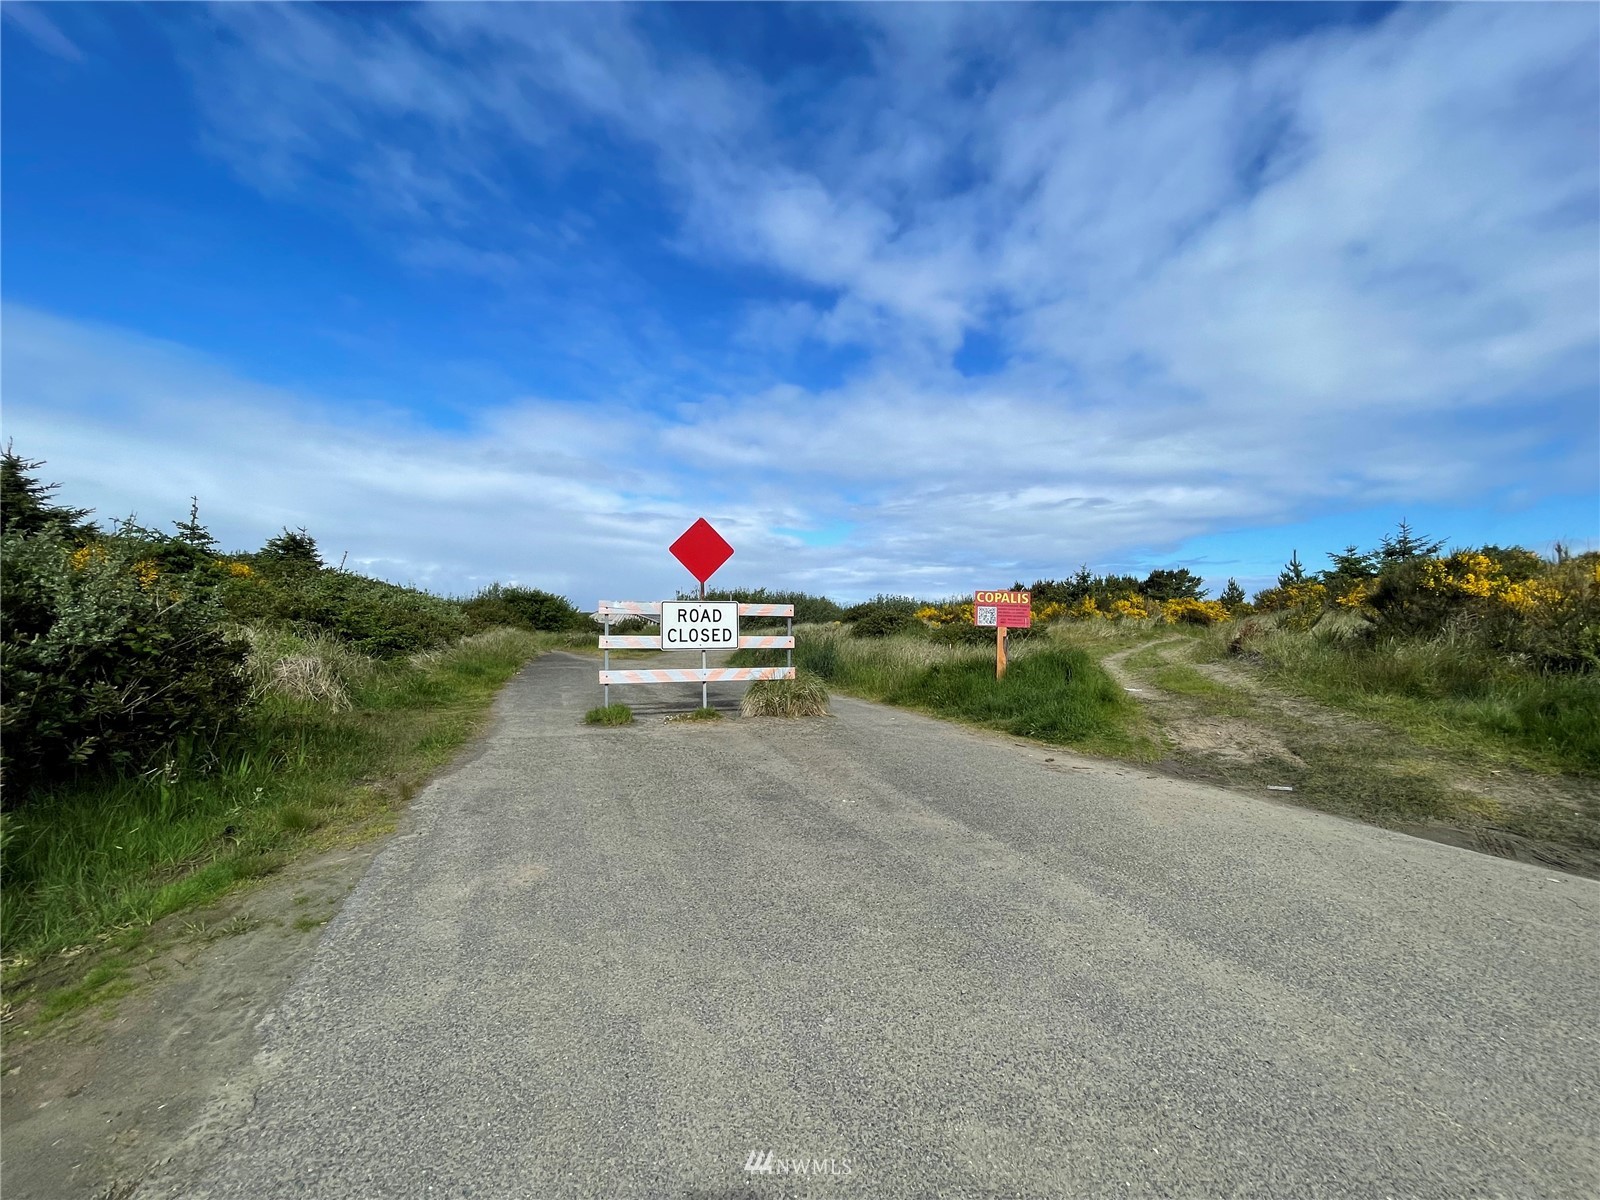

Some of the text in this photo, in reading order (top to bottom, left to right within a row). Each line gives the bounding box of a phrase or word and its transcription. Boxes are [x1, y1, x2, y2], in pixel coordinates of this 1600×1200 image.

[976, 592, 1029, 604] COPALIS
[677, 608, 722, 623] ROAD
[667, 628, 732, 643] CLOSED
